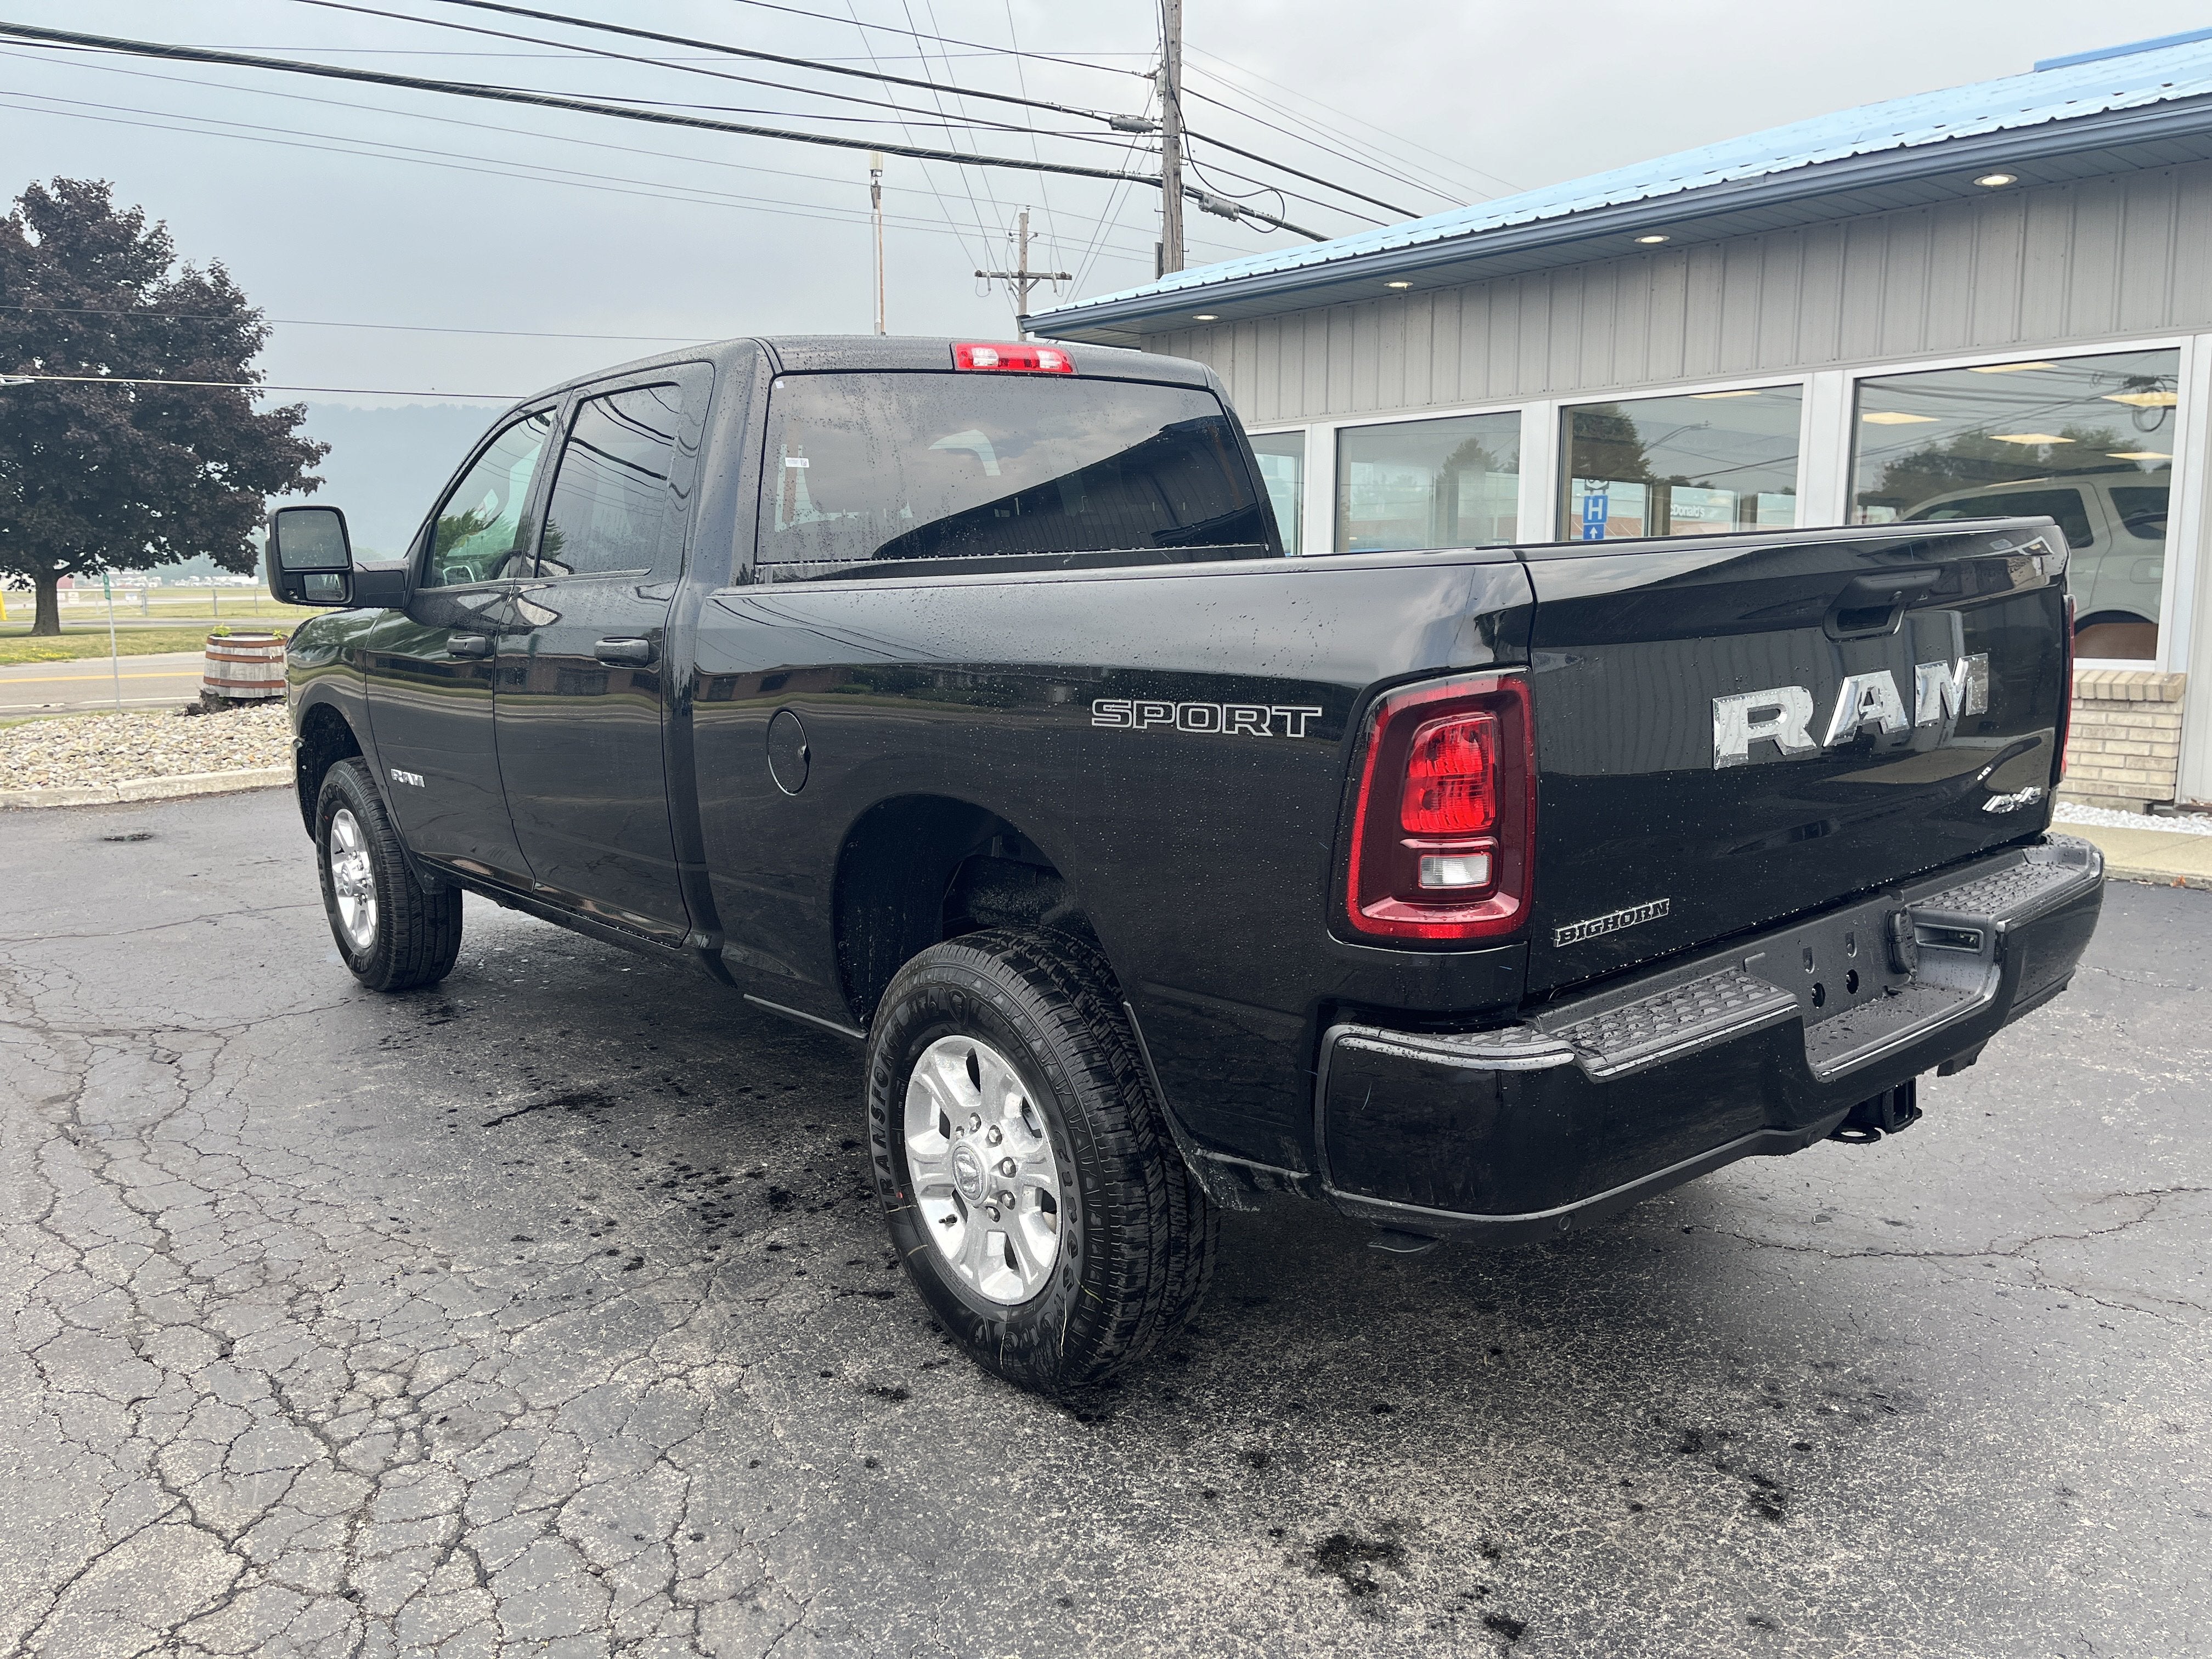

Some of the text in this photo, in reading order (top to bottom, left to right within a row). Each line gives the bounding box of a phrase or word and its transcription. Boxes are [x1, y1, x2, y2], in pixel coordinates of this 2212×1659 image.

[1588, 498, 1603, 521] H
[1092, 698, 1322, 738] SPORT
[1712, 652, 1989, 770] RAM
[391, 769, 425, 787] RAM
[1553, 898, 1670, 947] BIGHORN
[870, 1017, 906, 1212] TRANSFORCE
